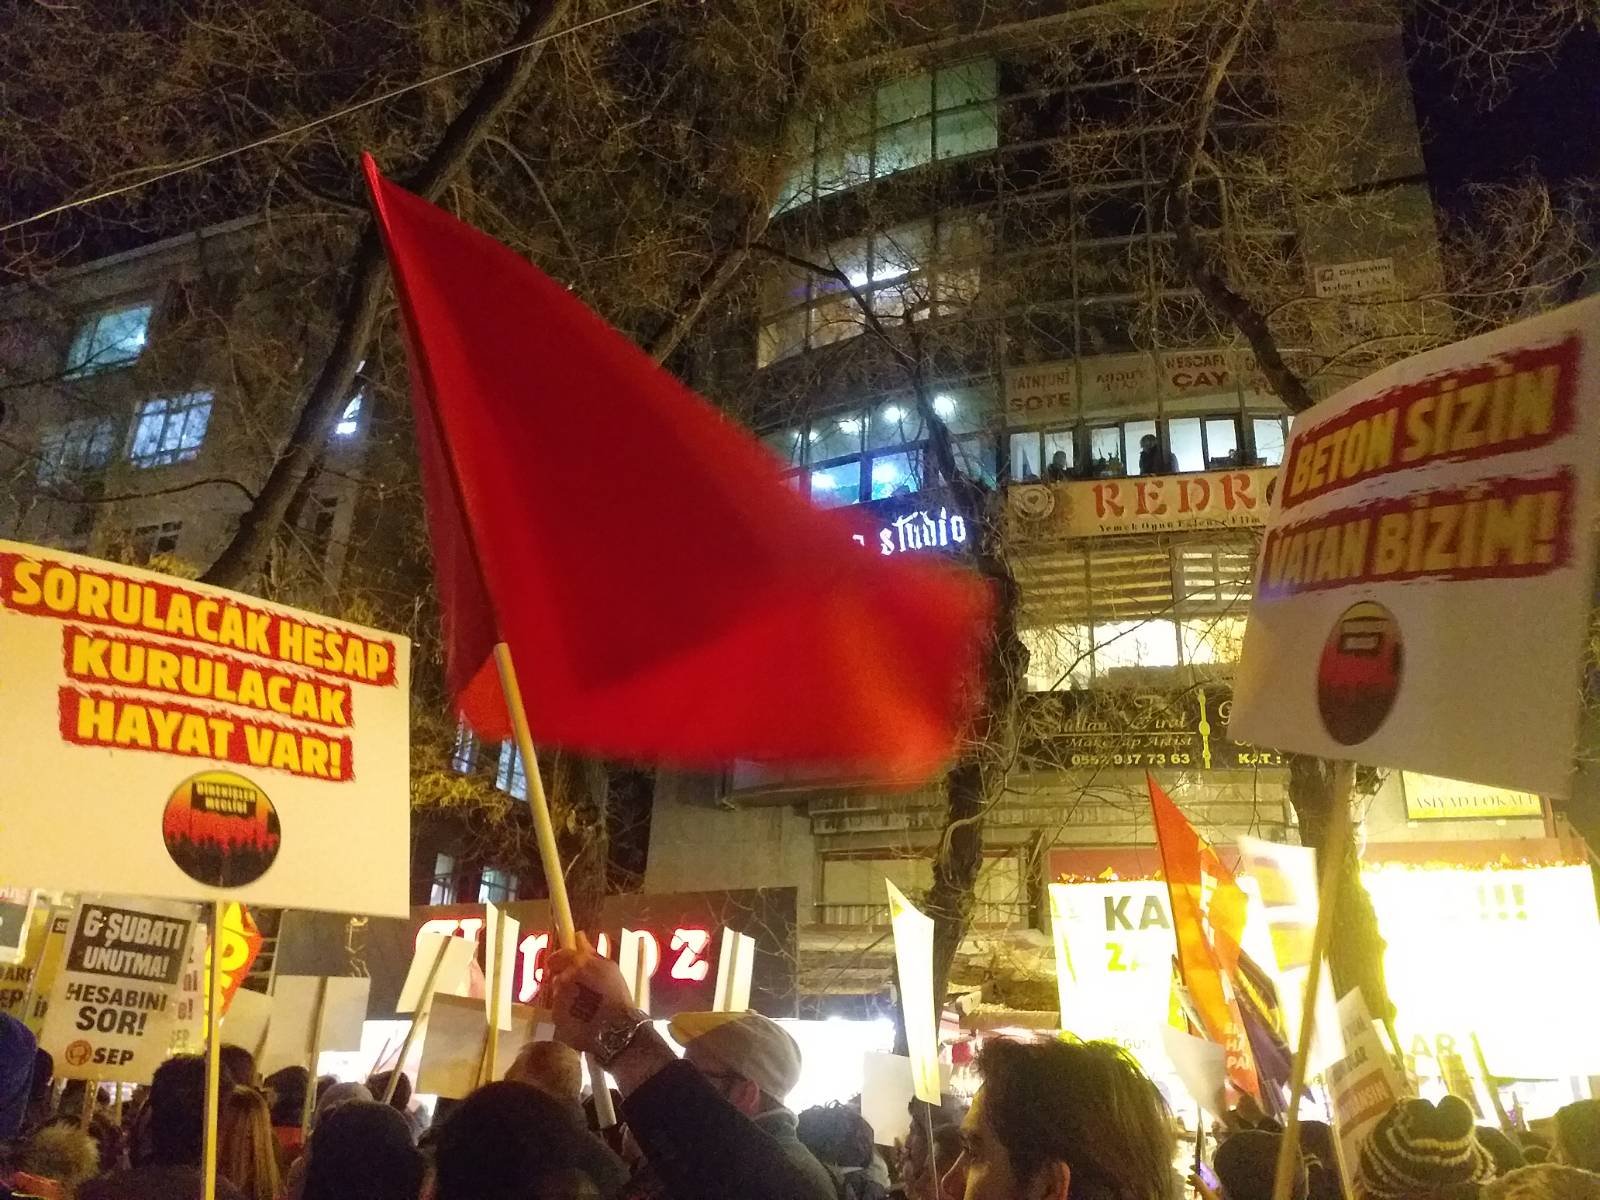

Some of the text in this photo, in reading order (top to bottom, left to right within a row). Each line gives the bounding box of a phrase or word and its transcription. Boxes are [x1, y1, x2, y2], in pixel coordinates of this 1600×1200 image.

[1171, 372, 1229, 391] ÇAY
[1289, 364, 1560, 497] BETON SİZİN
[879, 507, 967, 556] studio
[1268, 485, 1563, 588] VATAN BİZİM!
[12, 561, 390, 681] SORULACAK HESAP
[72, 636, 346, 726] KURULACAK
[77, 697, 341, 779] HAYAT VAR!
[1147, 754, 1166, 764] 73
[1170, 754, 1190, 764] 63
[105, 913, 184, 950] ŞUBATI
[83, 946, 170, 979] UNUTMA!
[66, 982, 168, 1012] HESABINI
[76, 1006, 147, 1037] SOR!
[92, 1047, 135, 1066] SEP
